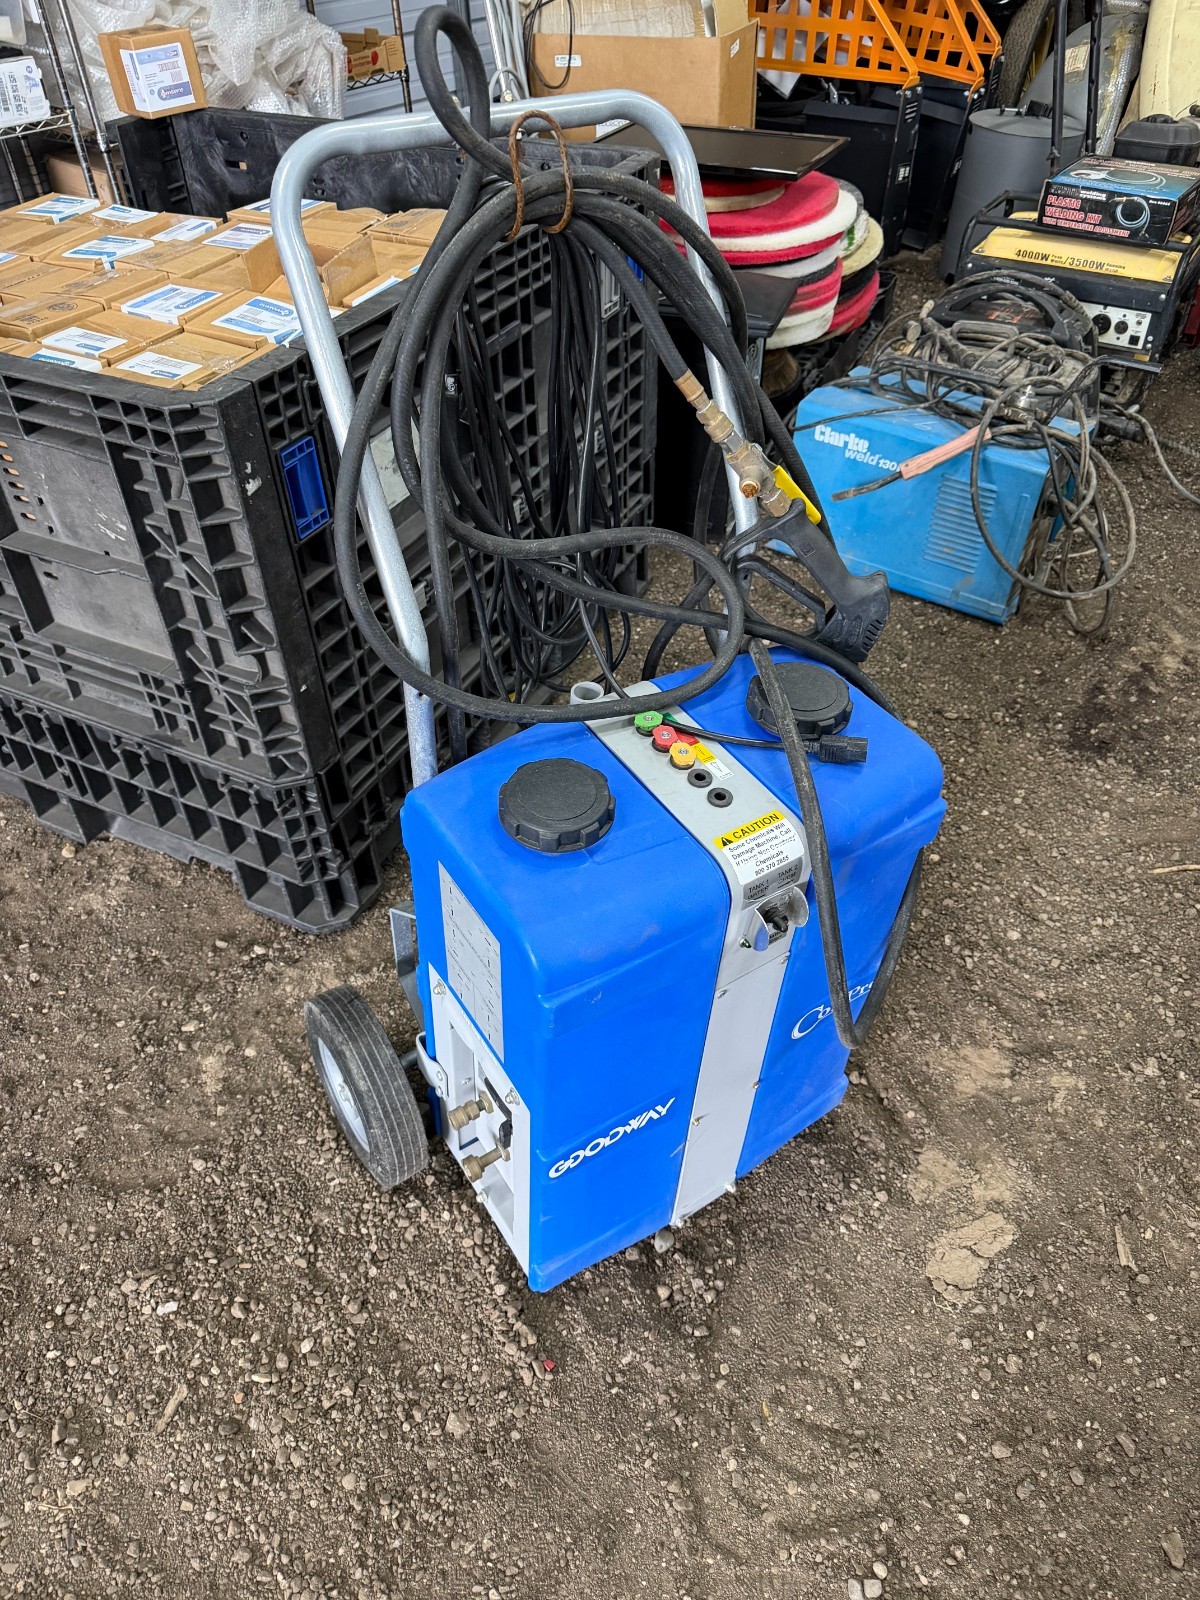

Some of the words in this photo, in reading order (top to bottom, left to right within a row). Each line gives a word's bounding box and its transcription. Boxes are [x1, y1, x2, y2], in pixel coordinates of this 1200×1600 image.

[1046, 195, 1082, 209] PLASTIC
[1045, 206, 1085, 221] WELDING
[1086, 212, 1102, 224] KIT
[1042, 217, 1057, 225] WITH
[1057, 219, 1094, 231] TEMPERATURE
[1093, 226, 1131, 237] ADJUSTMENT
[1015, 249, 1050, 262] 4000W
[814, 424, 869, 453] Clarke
[845, 448, 879, 466] weld
[732, 813, 780, 839] CAUTION
[728, 842, 746, 853] Some
[745, 828, 775, 845] Chemicals
[773, 822, 786, 831] Will
[731, 846, 756, 860] Damage
[779, 827, 792, 837] Call
[755, 850, 784, 867] Chemicals
[778, 866, 793, 878] TANK
[748, 882, 765, 893] TANK
[548, 1097, 676, 1178] GOODWAY
